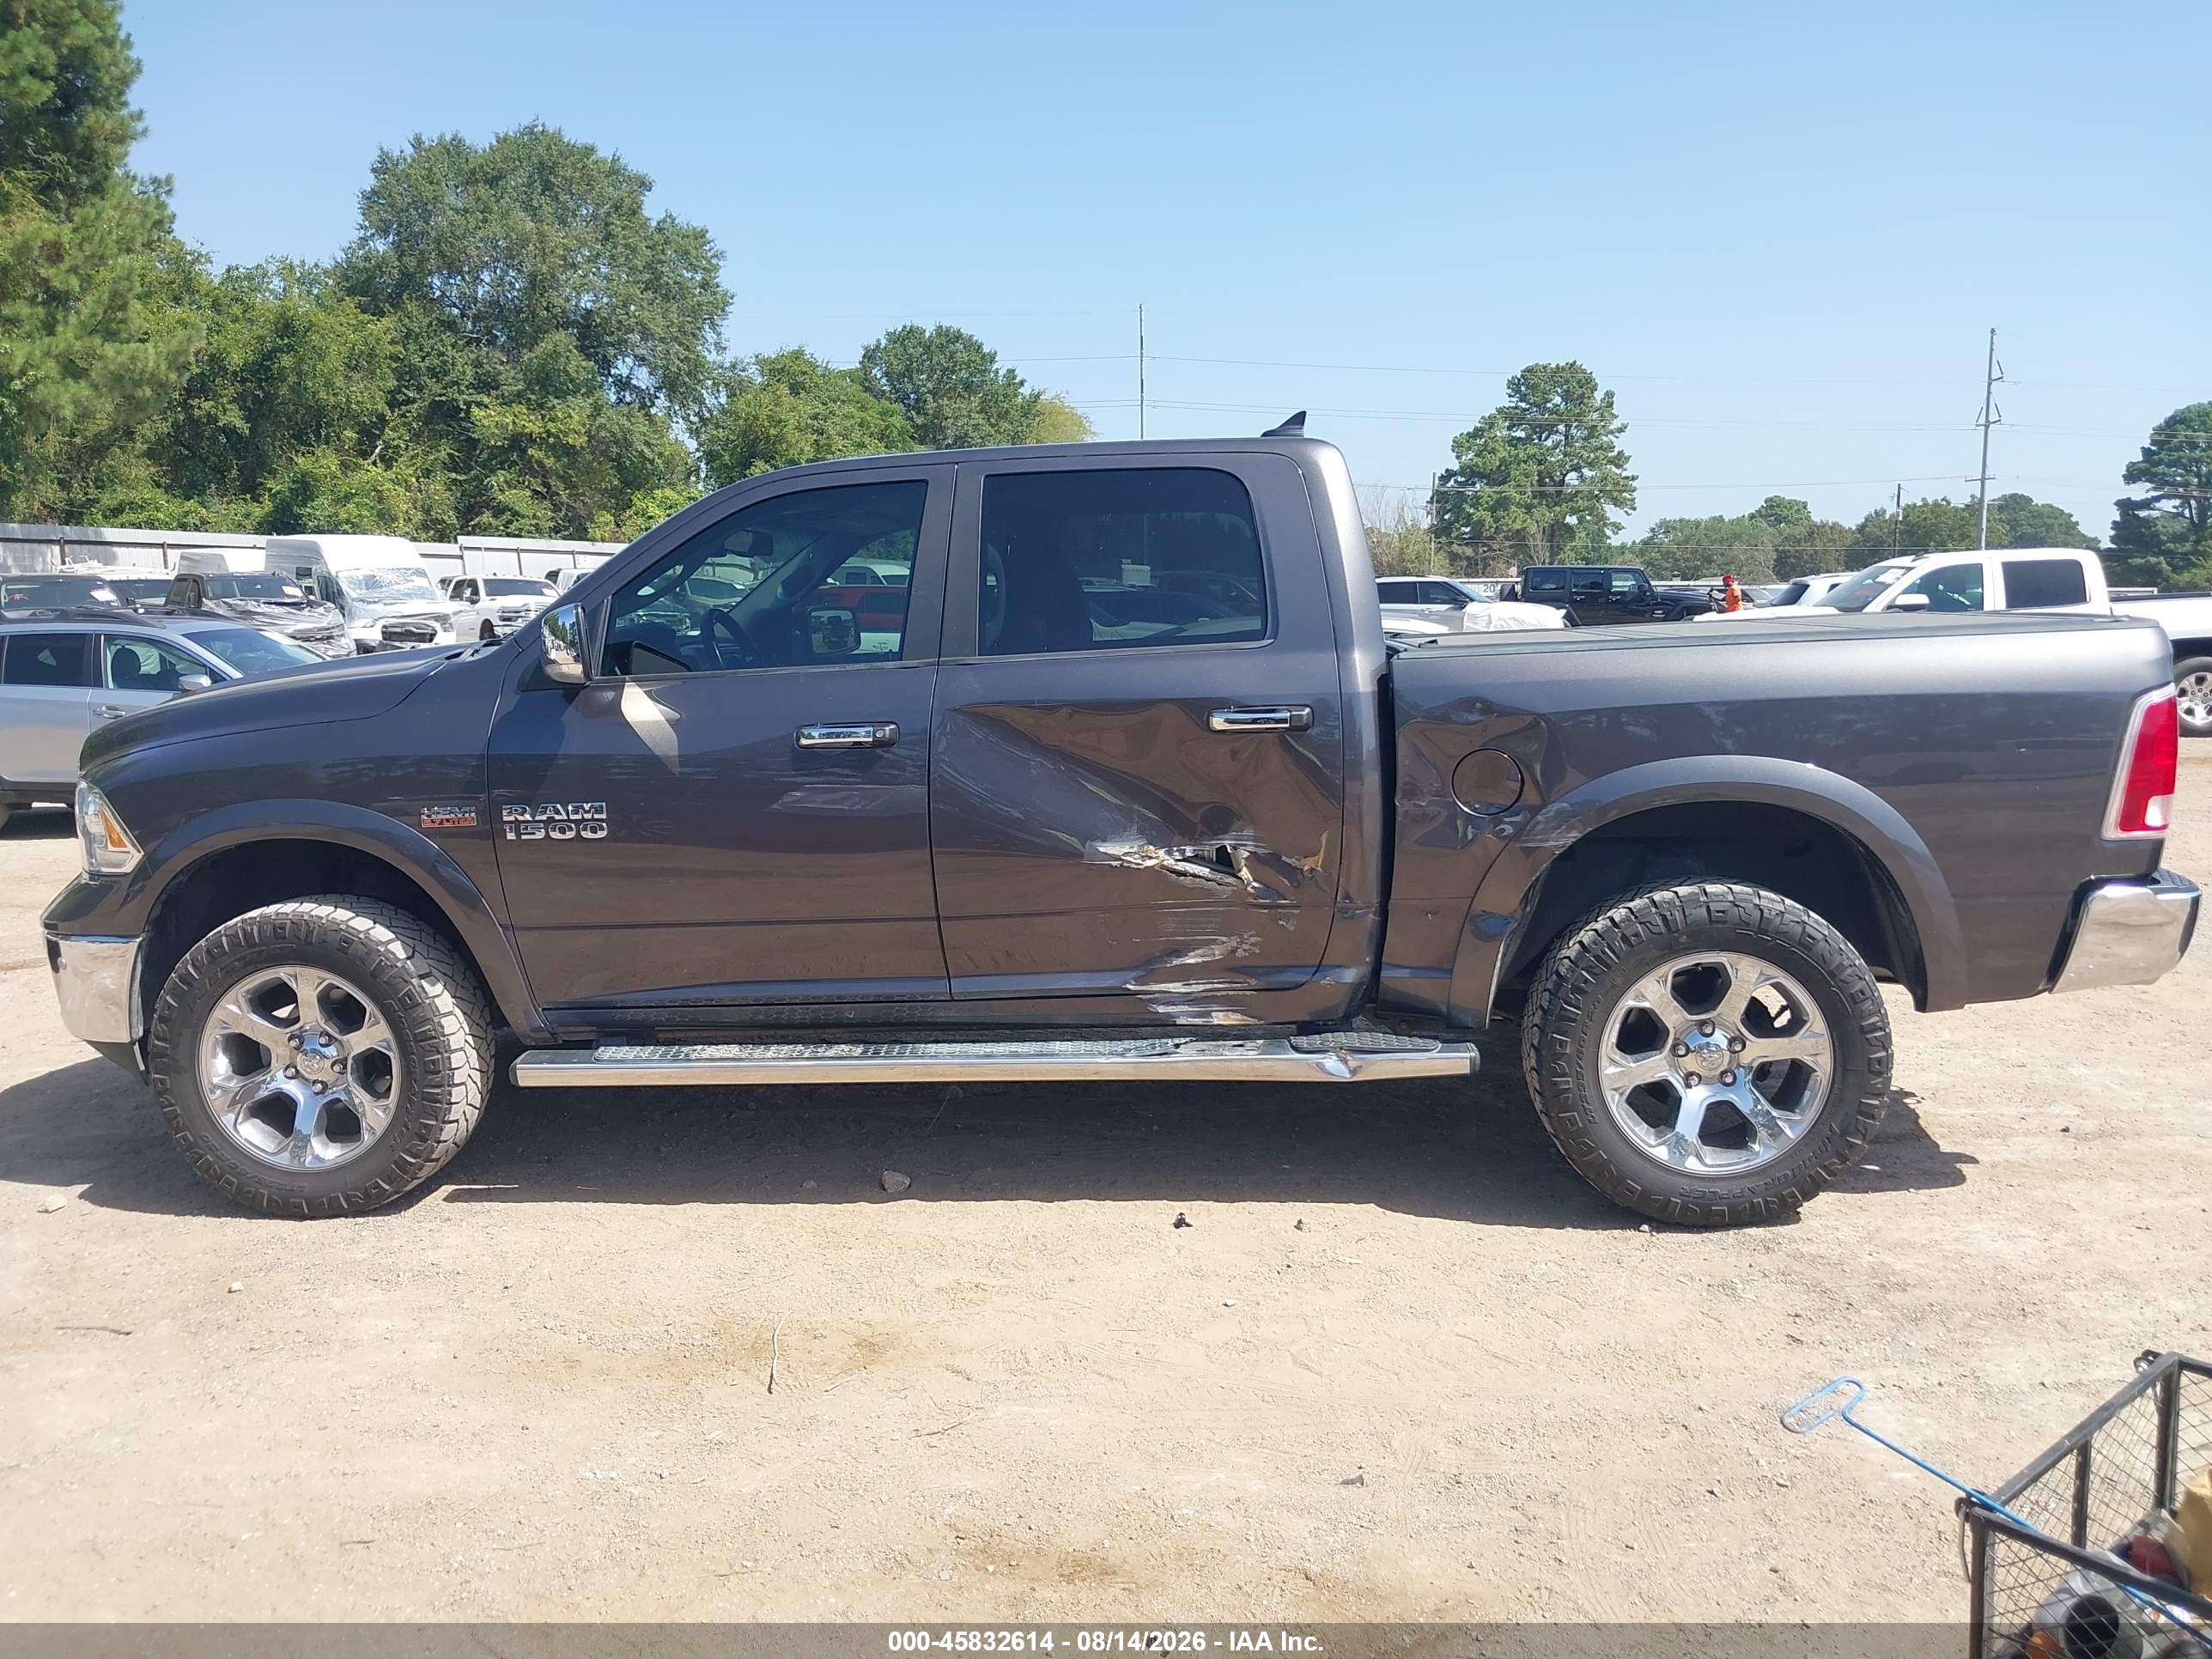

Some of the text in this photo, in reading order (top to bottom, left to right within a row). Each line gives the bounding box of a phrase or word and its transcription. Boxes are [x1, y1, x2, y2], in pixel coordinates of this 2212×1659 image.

[421, 806, 476, 817] HEMI
[501, 802, 606, 821] RAM
[503, 822, 608, 840] 1500
